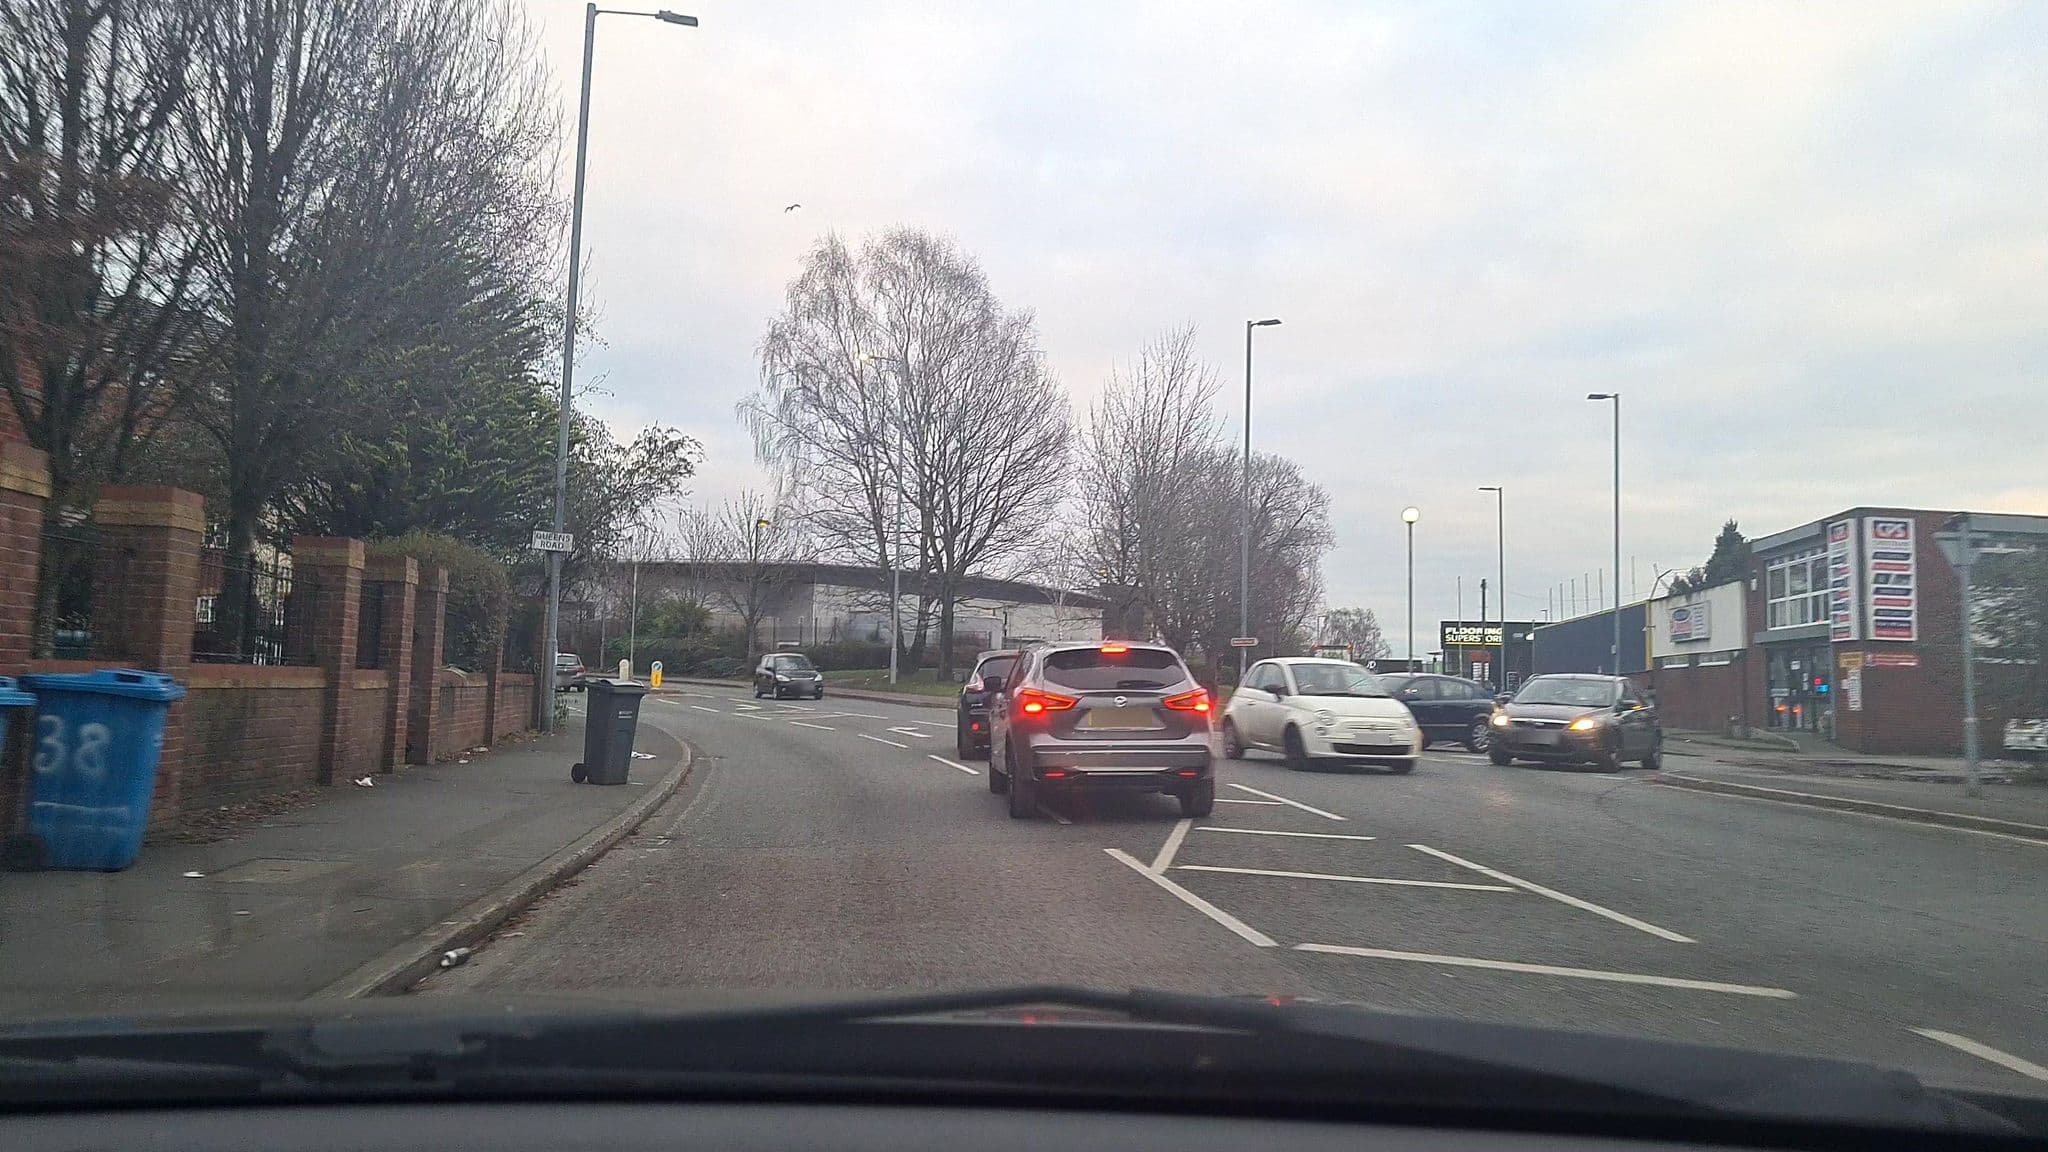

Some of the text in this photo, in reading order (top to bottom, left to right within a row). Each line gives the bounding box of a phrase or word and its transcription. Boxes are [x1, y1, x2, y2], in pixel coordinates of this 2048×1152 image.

[536, 532, 570, 542] QUEENS
[541, 540, 564, 549] ROAD
[1445, 627, 1502, 635] FLOORING
[1445, 634, 1502, 642] SUPERSOR
[34, 714, 111, 780] 38
